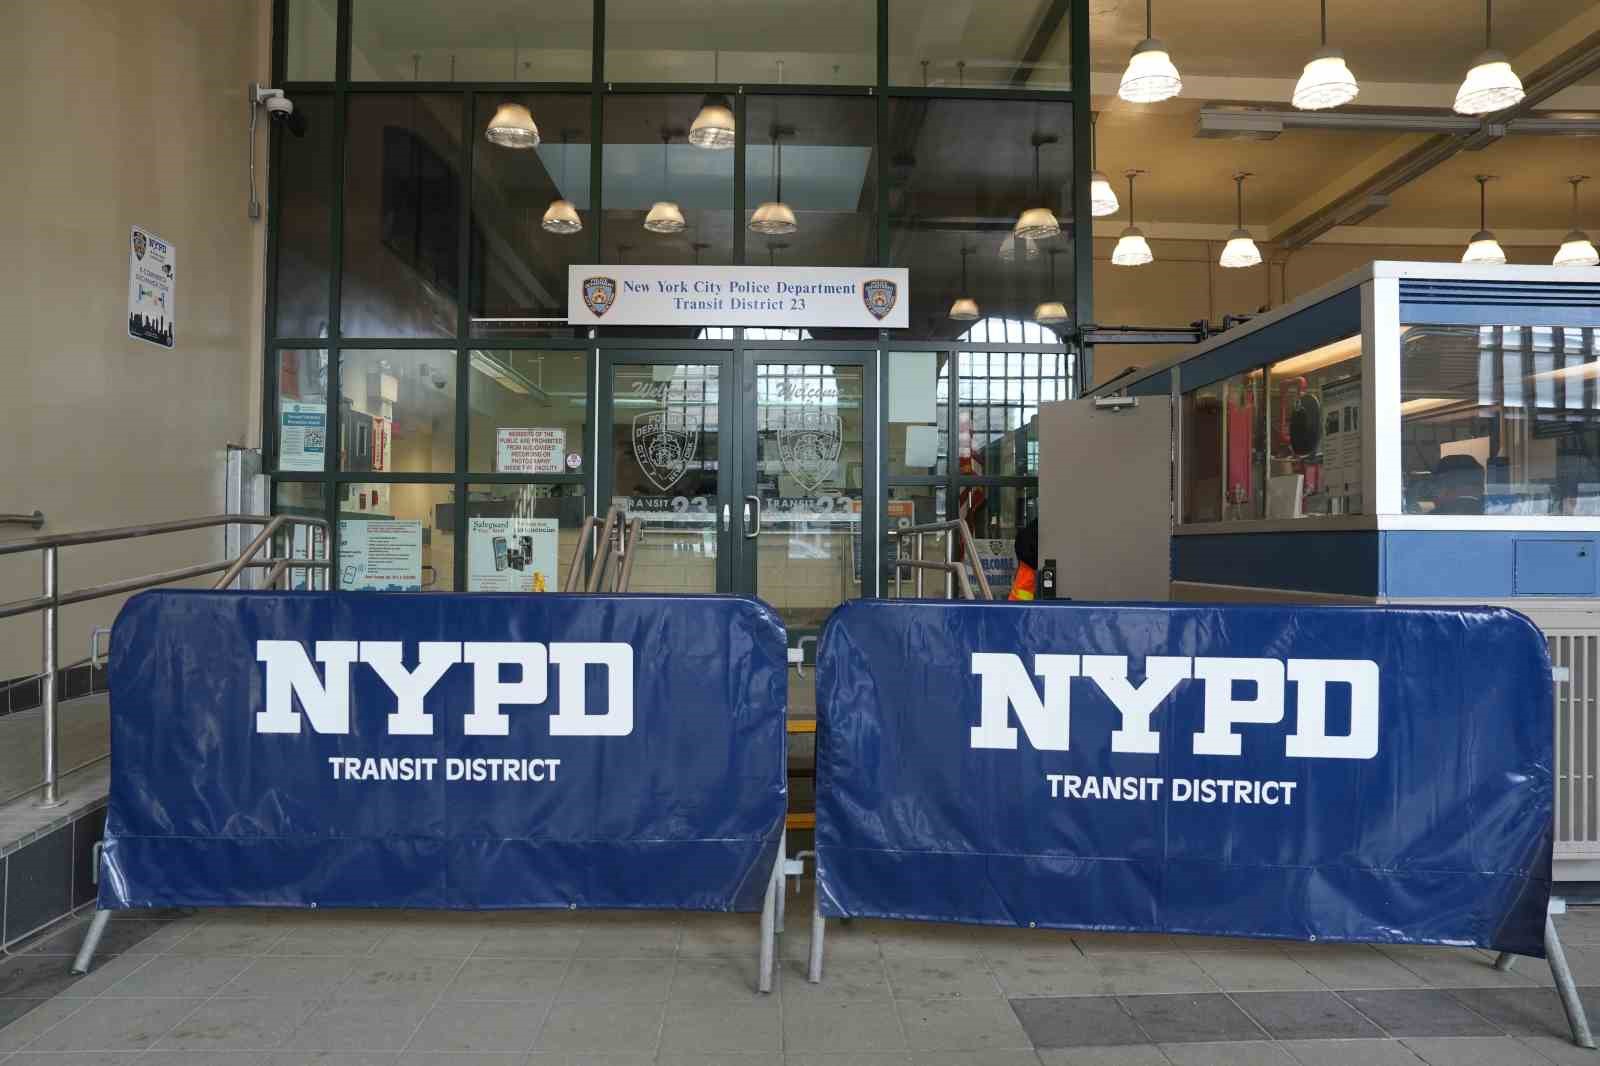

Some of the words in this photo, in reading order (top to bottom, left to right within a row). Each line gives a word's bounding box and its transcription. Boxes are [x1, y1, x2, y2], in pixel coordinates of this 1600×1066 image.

[623, 280, 650, 293] New
[657, 280, 689, 293] York
[694, 280, 722, 296] City
[729, 280, 770, 293] Police
[776, 281, 856, 296] Department
[672, 297, 723, 310] Transit
[730, 298, 784, 311] District
[790, 298, 806, 311] 23
[256, 640, 634, 736] NYPD
[970, 652, 1380, 760] NYPD
[329, 757, 438, 781] TRANSIT
[446, 758, 561, 782] DISTRICT
[1046, 774, 1164, 801] TRANSIT
[1172, 778, 1297, 804] DISTRICT
